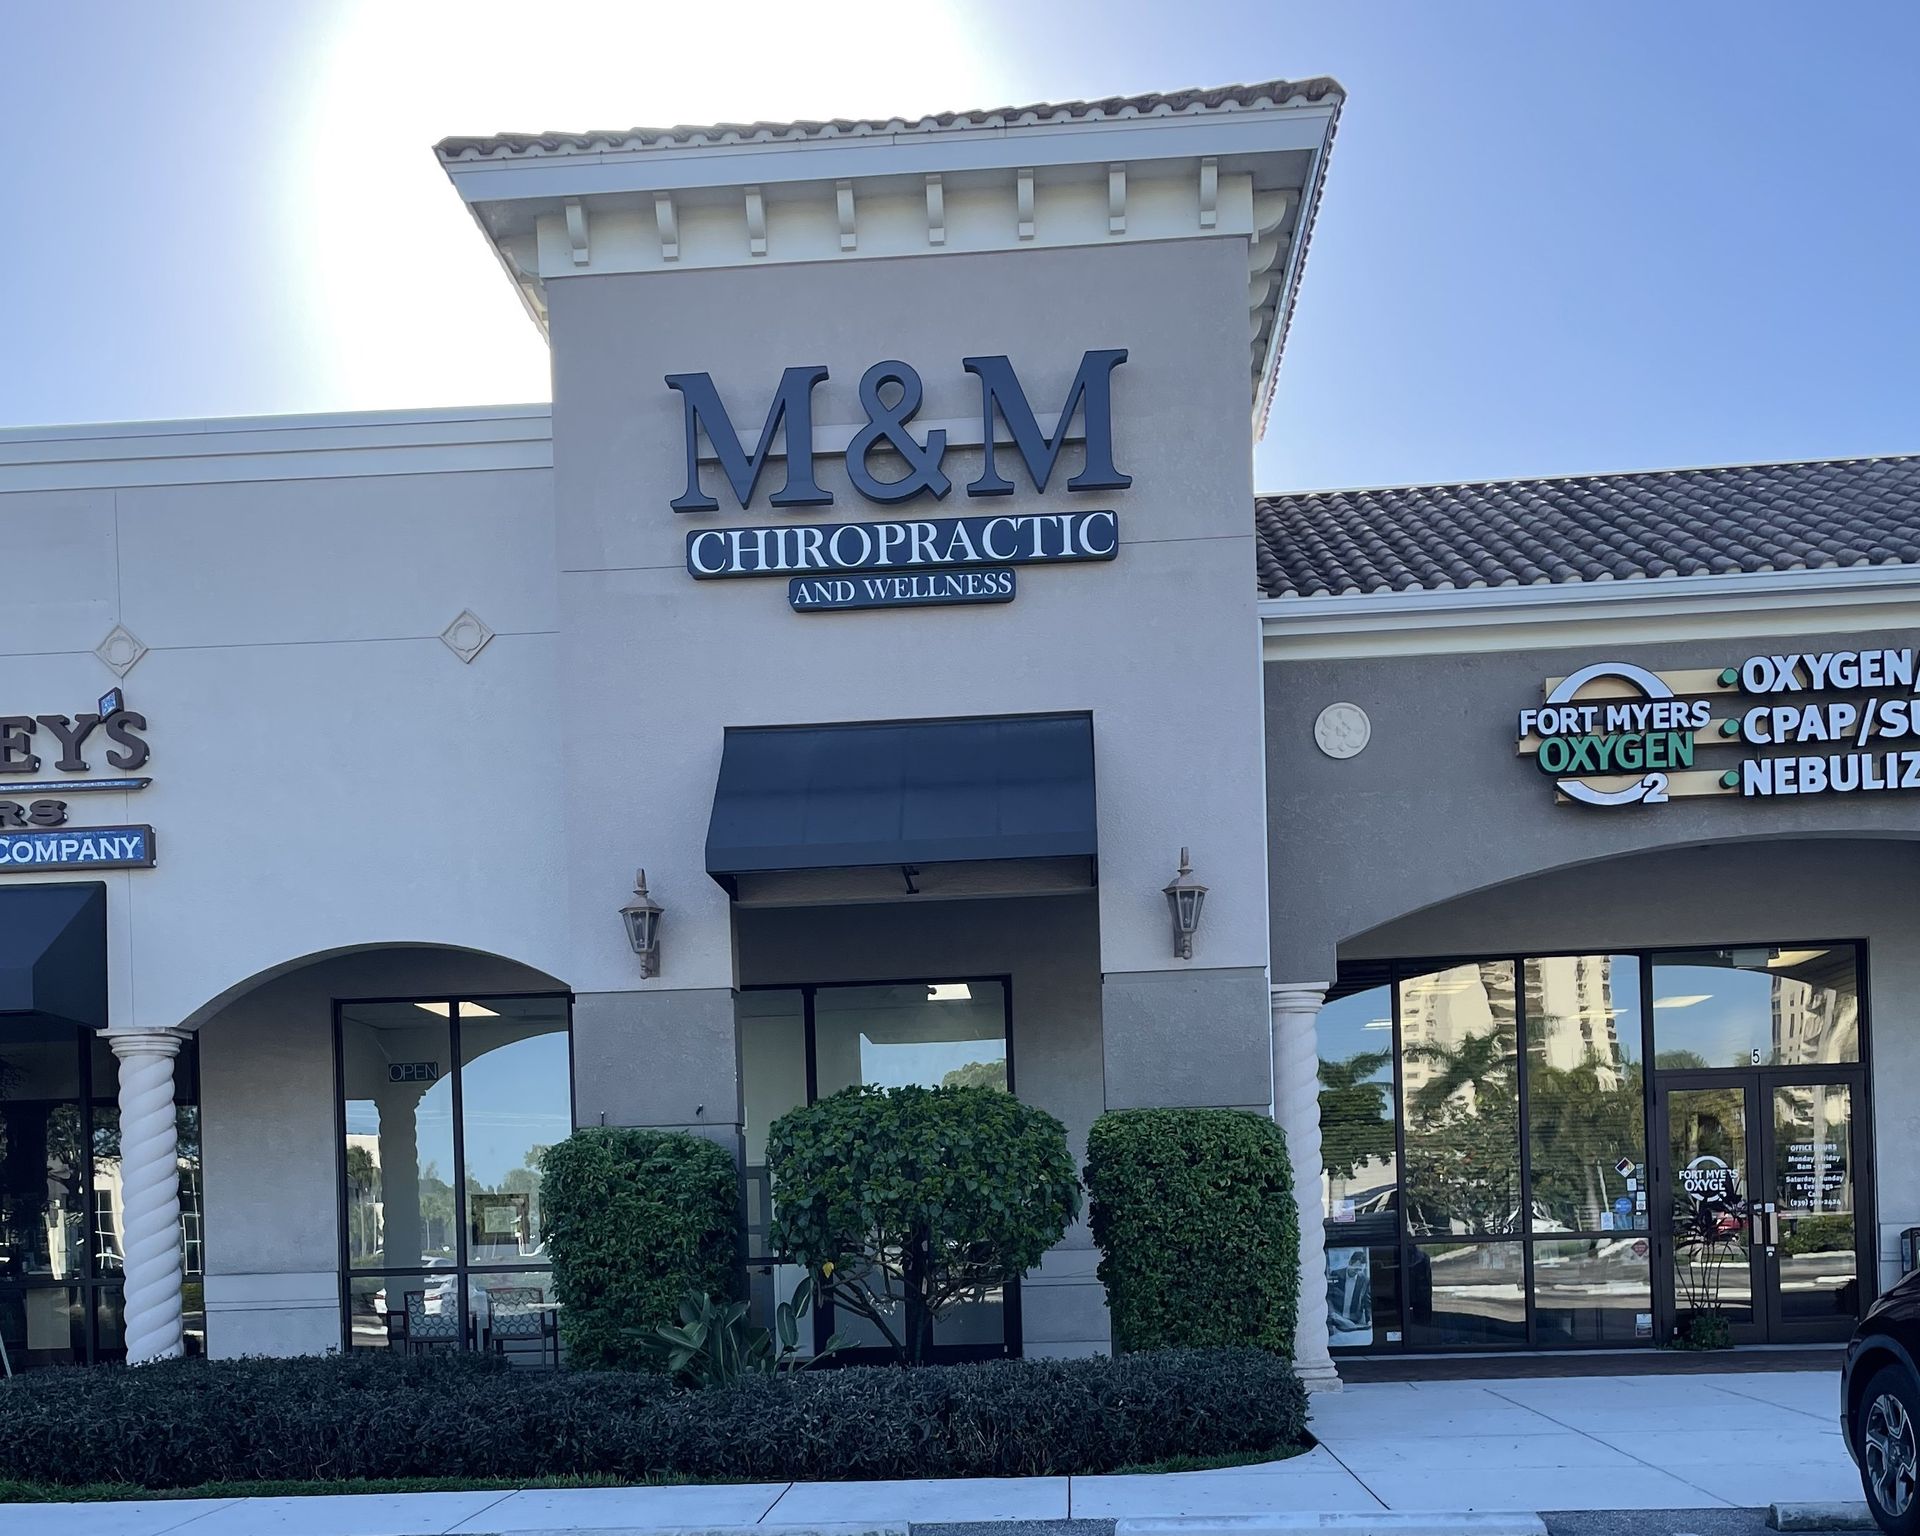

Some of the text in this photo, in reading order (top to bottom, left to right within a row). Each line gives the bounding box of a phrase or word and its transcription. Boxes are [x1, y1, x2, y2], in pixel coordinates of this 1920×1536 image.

[665, 349, 1132, 513] M&M
[690, 511, 1116, 575] CHIROPRACTIC
[794, 572, 1013, 604] AND WELLNESS
[1742, 648, 1920, 693] OXYGEN
[1519, 700, 1711, 736] FORT MYERS
[1538, 731, 1695, 773] OXYGEN
[1642, 772, 1669, 804] 2
[1743, 750, 1920, 796] NEBULIZ
[389, 1063, 438, 1081] OPEN
[1753, 1048, 1760, 1064] 5
[1788, 1155, 1815, 1163] Monday
[1790, 1144, 1812, 1152] OFFICE
[1678, 1170, 1704, 1180] FORT
[1684, 1179, 1737, 1192] OXYGE
